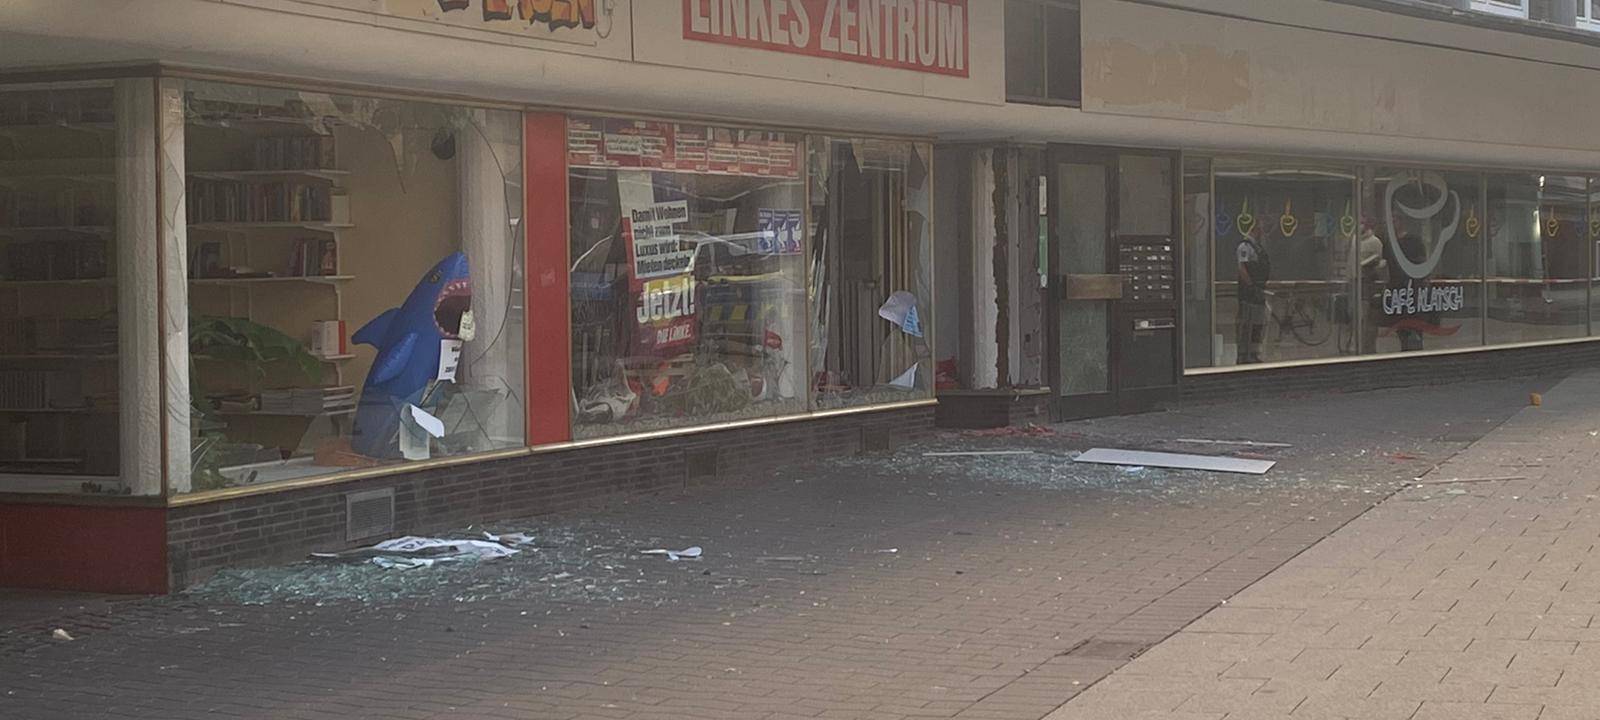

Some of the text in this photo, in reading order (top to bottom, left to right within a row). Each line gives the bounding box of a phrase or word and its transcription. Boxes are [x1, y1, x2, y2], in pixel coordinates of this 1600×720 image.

[820, 0, 964, 70] ZENTRUM
[636, 275, 696, 324] Jetzt!
[1417, 286, 1464, 313] KLATSCH
